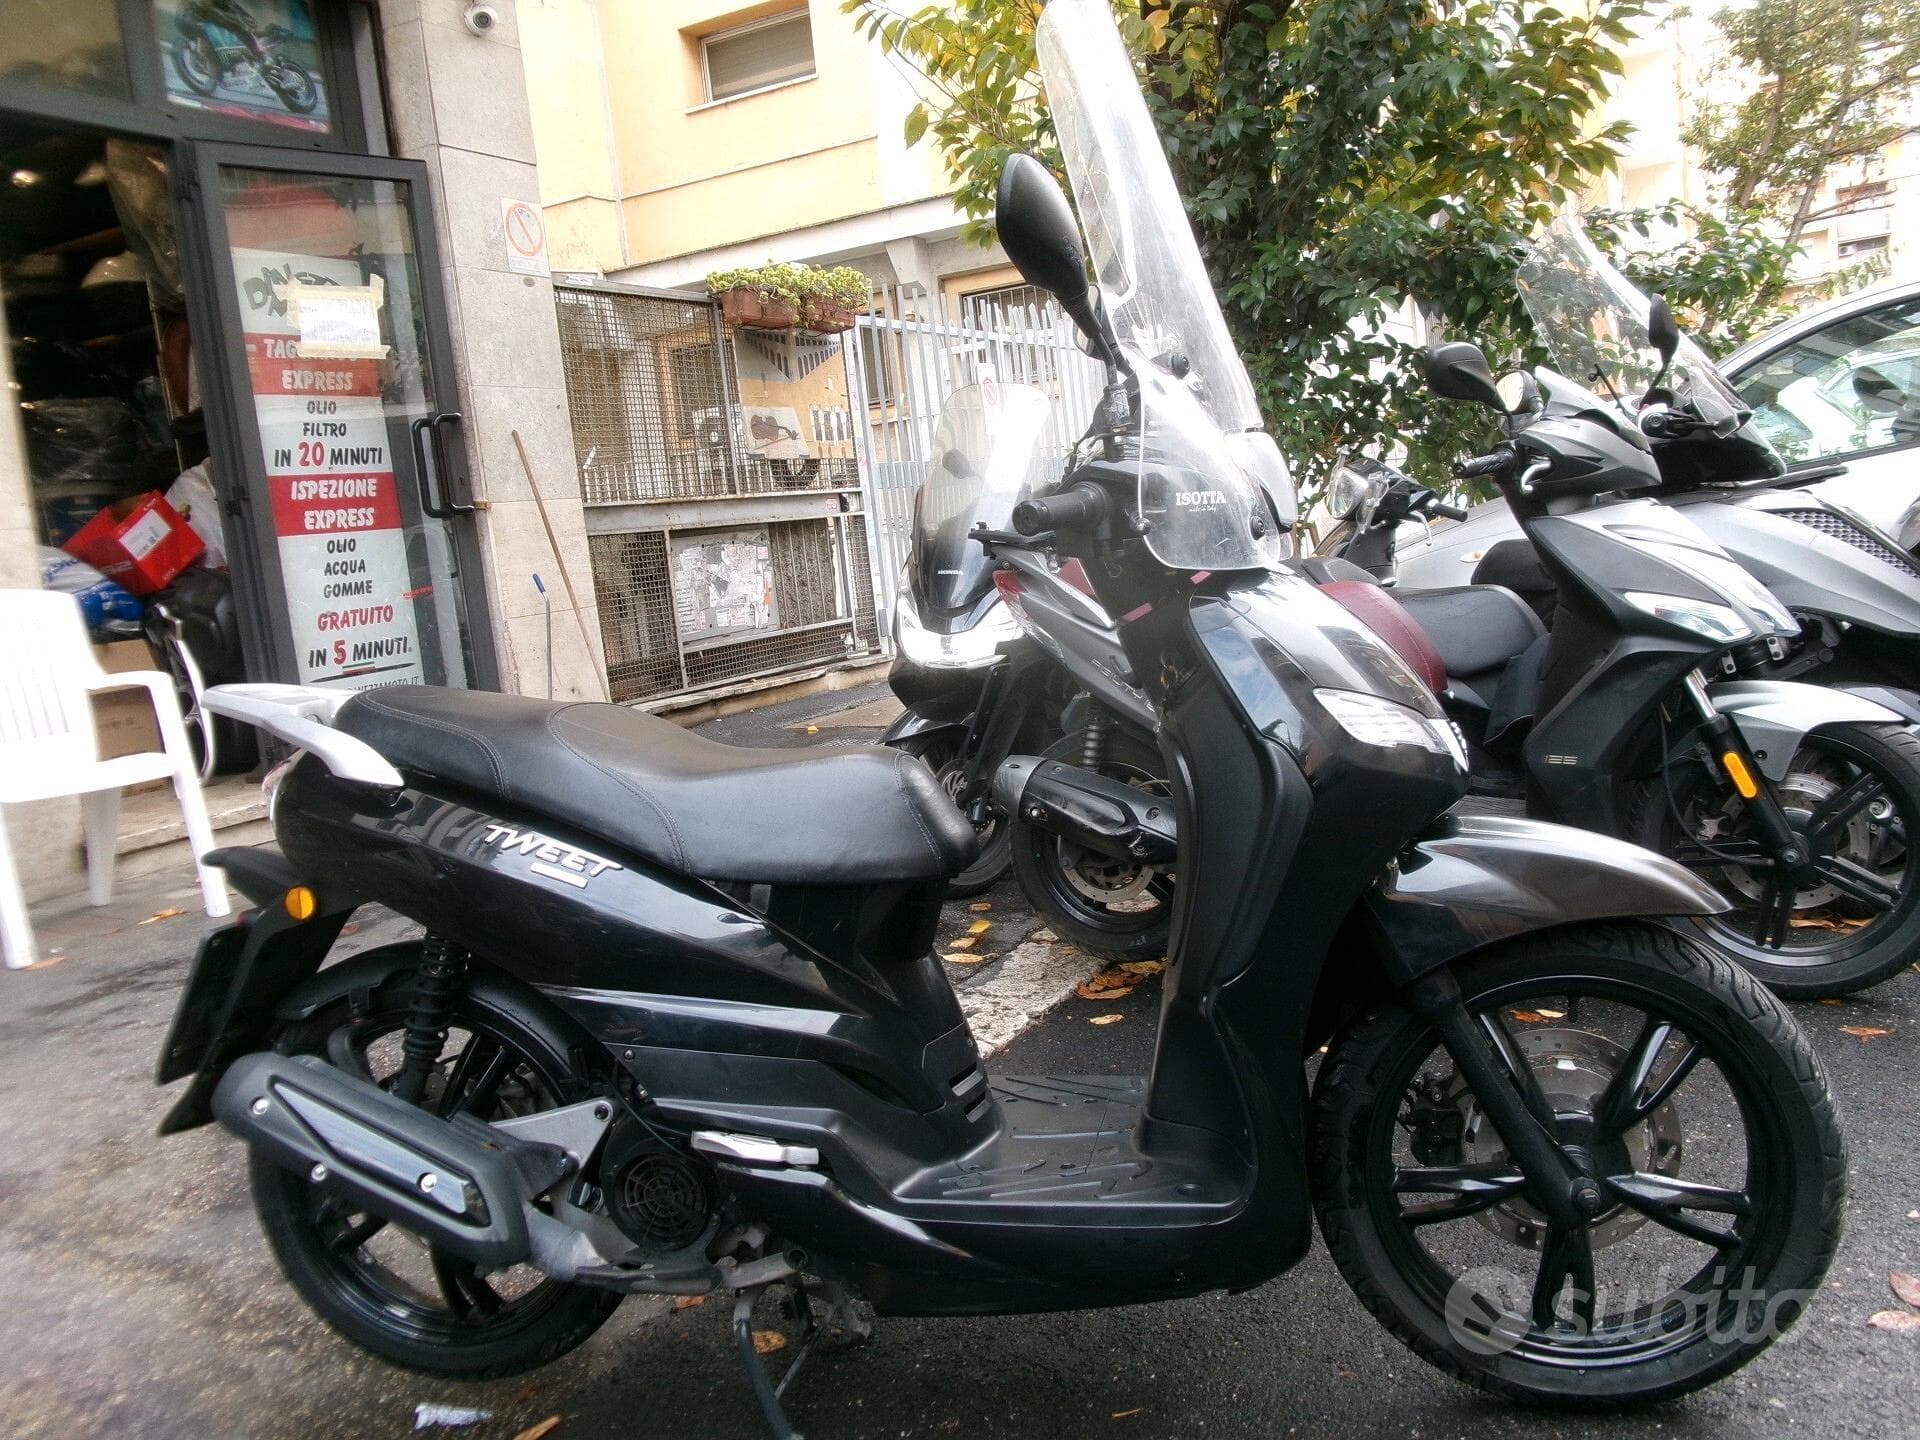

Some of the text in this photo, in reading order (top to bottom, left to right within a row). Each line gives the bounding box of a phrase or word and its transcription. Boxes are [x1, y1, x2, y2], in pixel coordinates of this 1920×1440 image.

[281, 369, 354, 392] EXPRESS
[306, 400, 338, 415] OLIO
[302, 422, 347, 437] FILTRO
[274, 441, 383, 468] IN 20 MINUTI
[291, 478, 377, 500] ISPEZIONE
[1175, 490, 1227, 506] ISOTTA
[303, 507, 376, 531] EXPRESS
[326, 538, 357, 555] OLIO
[323, 559, 367, 577] ACQUA
[323, 580, 374, 599] GOMME
[317, 604, 395, 632] GRATUITO
[307, 649, 328, 669] IN
[332, 639, 347, 665] 5
[484, 824, 625, 877] TWEET
